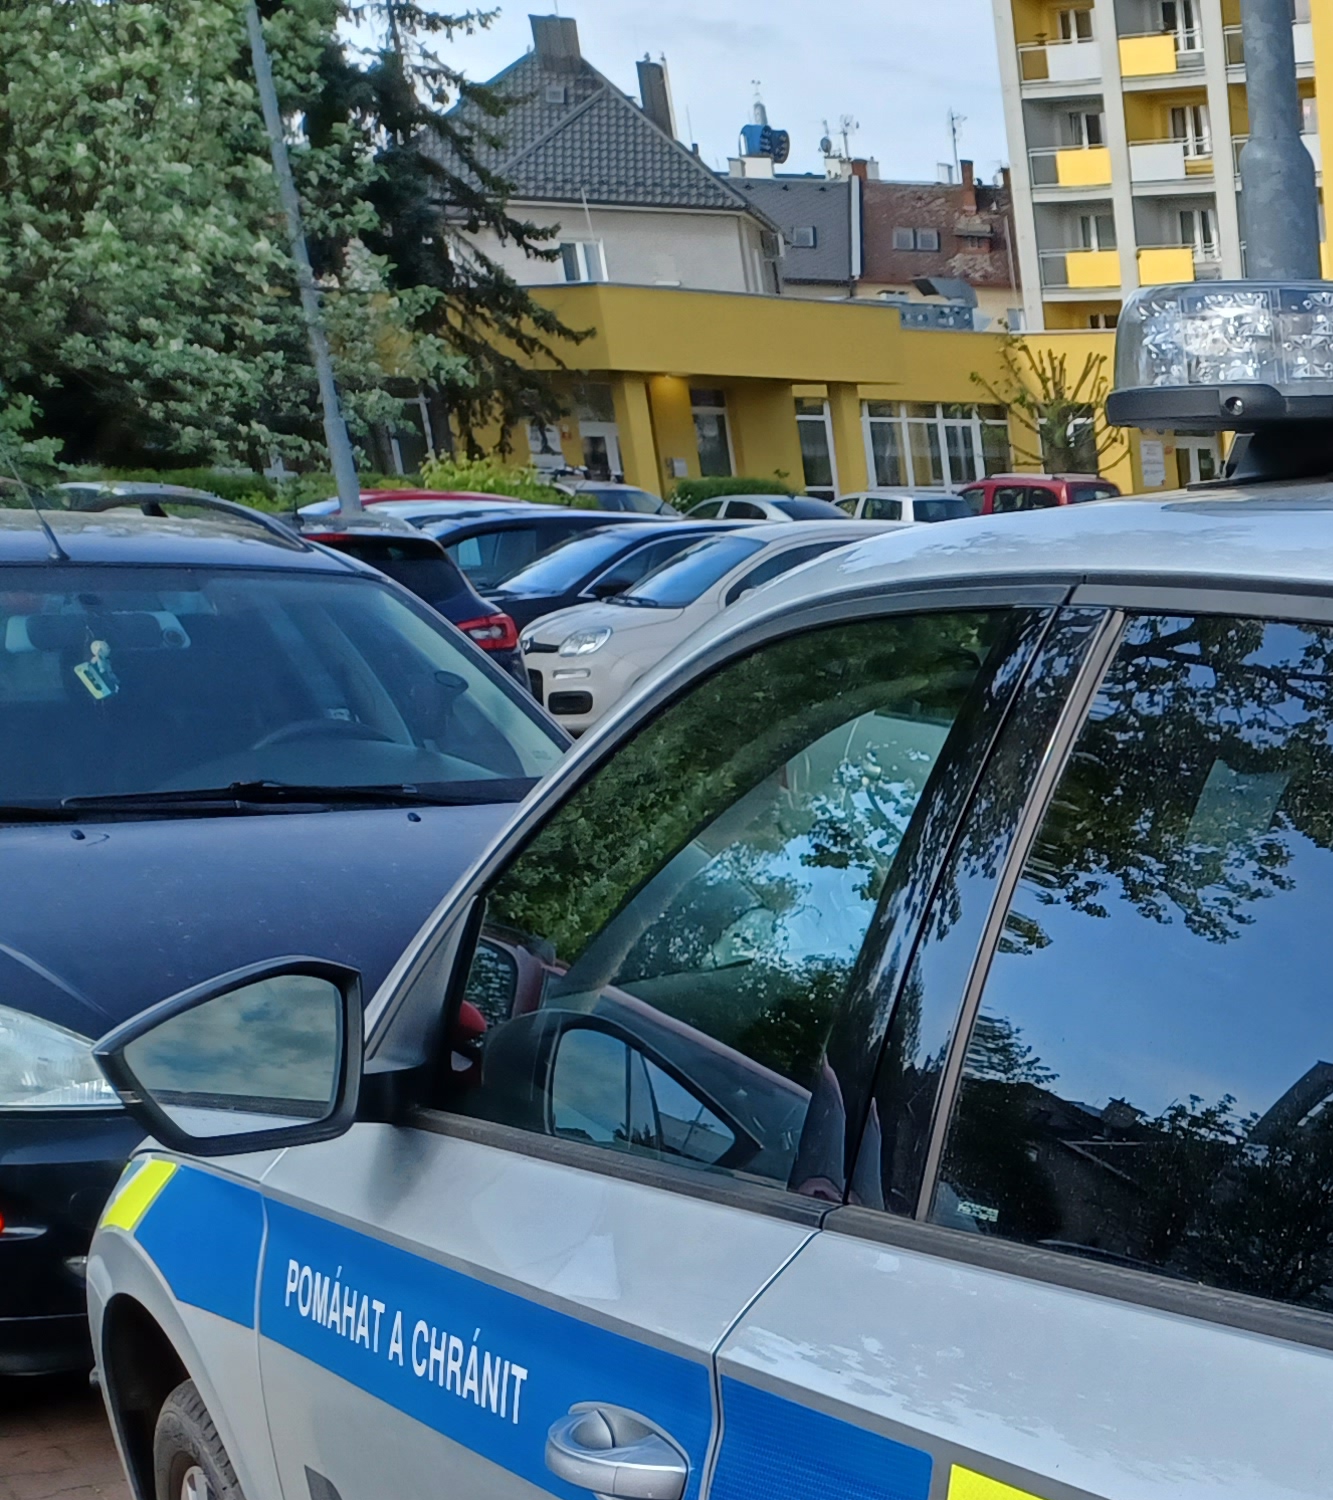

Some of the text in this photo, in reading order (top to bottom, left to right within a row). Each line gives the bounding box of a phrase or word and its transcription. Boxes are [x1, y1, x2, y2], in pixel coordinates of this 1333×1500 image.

[286, 1259, 528, 1424] POMÁHAT A CHRÁNIT
